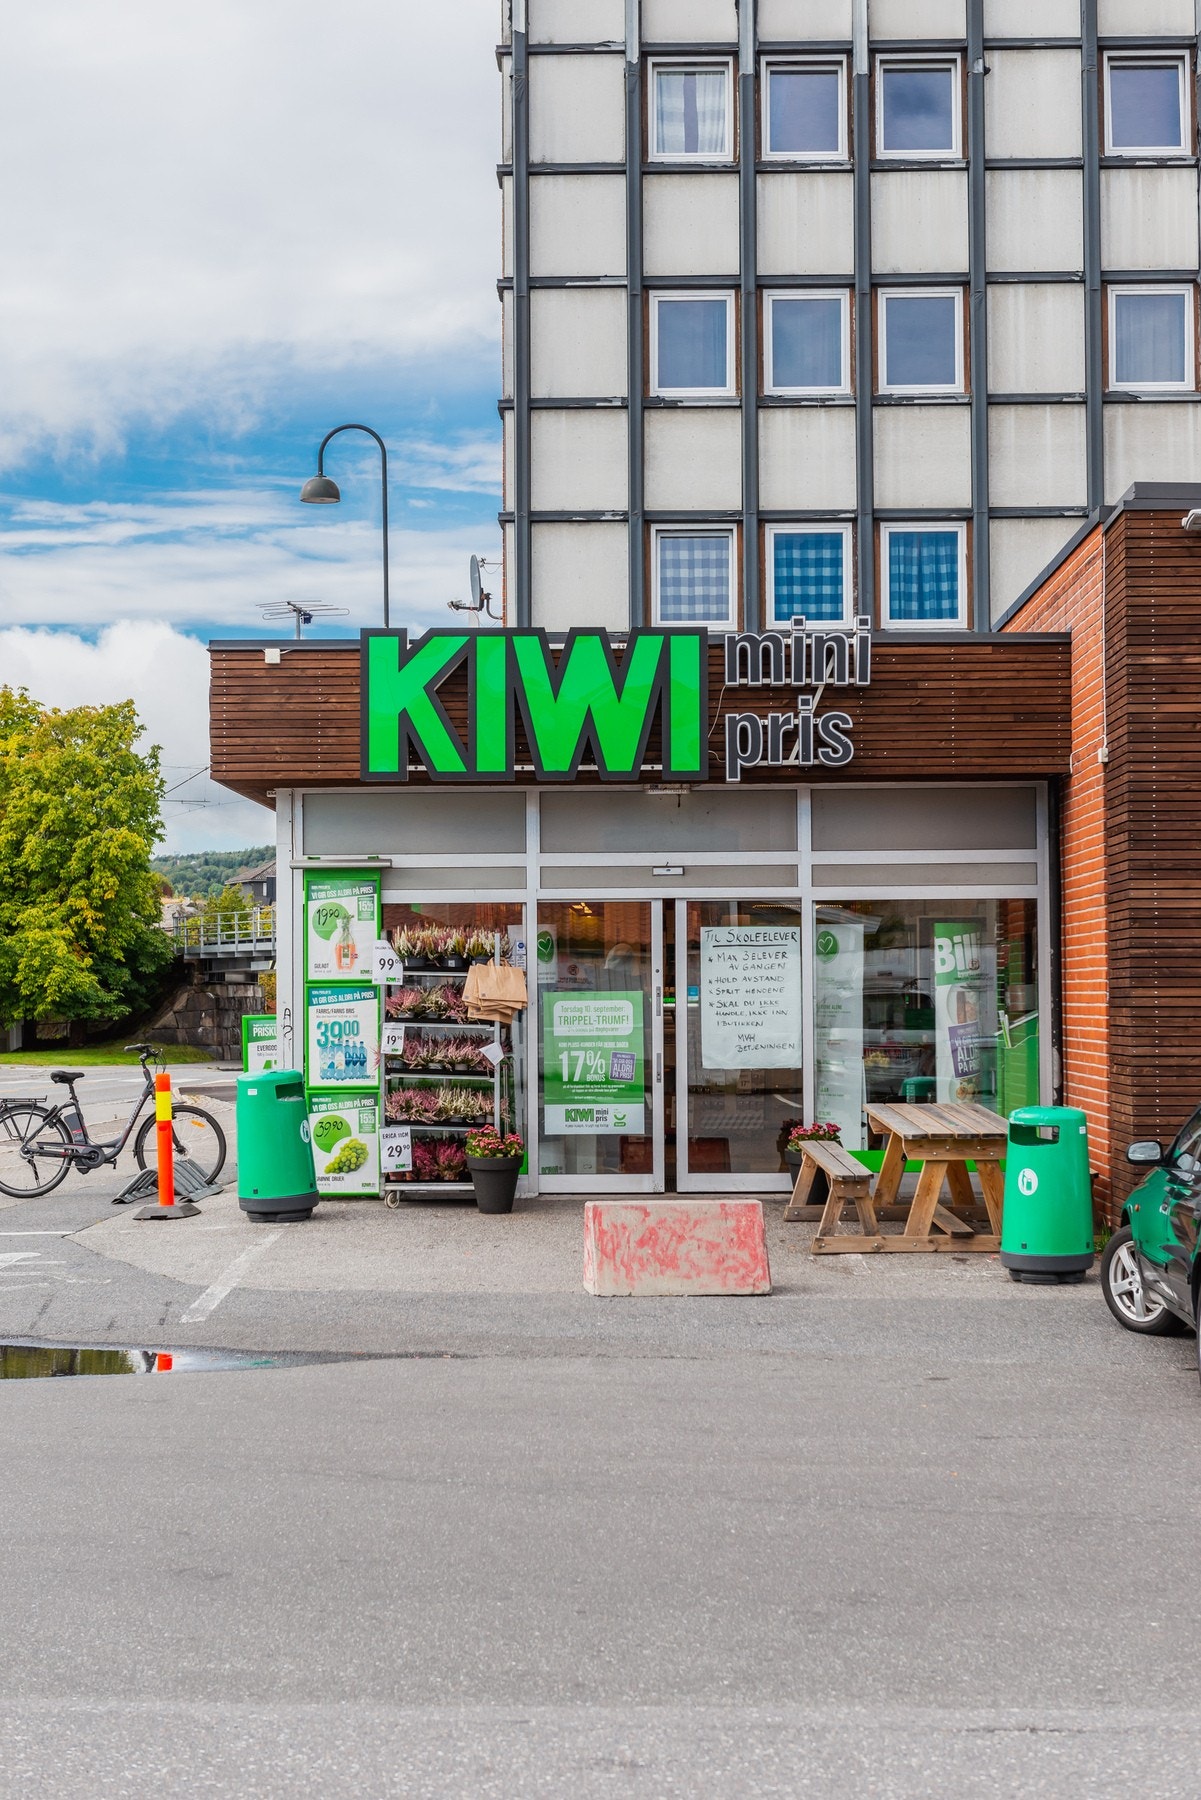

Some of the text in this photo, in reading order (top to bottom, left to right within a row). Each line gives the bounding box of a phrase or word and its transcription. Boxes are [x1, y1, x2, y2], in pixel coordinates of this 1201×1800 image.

[360, 616, 871, 781] KIWI mini
[725, 695, 854, 782] pris
[705, 929, 797, 942] TIL SKOLEELEVER
[717, 952, 737, 962] MAX
[354, 992, 360, 1000] PÅ
[716, 987, 740, 995] SPRIT
[561, 1005, 583, 1014] Torsdag
[558, 1015, 629, 1025] TRIPPEL-TRUMF!
[559, 1050, 605, 1081] 17%
[354, 1099, 360, 1108] PÅ
[565, 1108, 594, 1122] KIWI
[596, 1115, 607, 1123] pris
